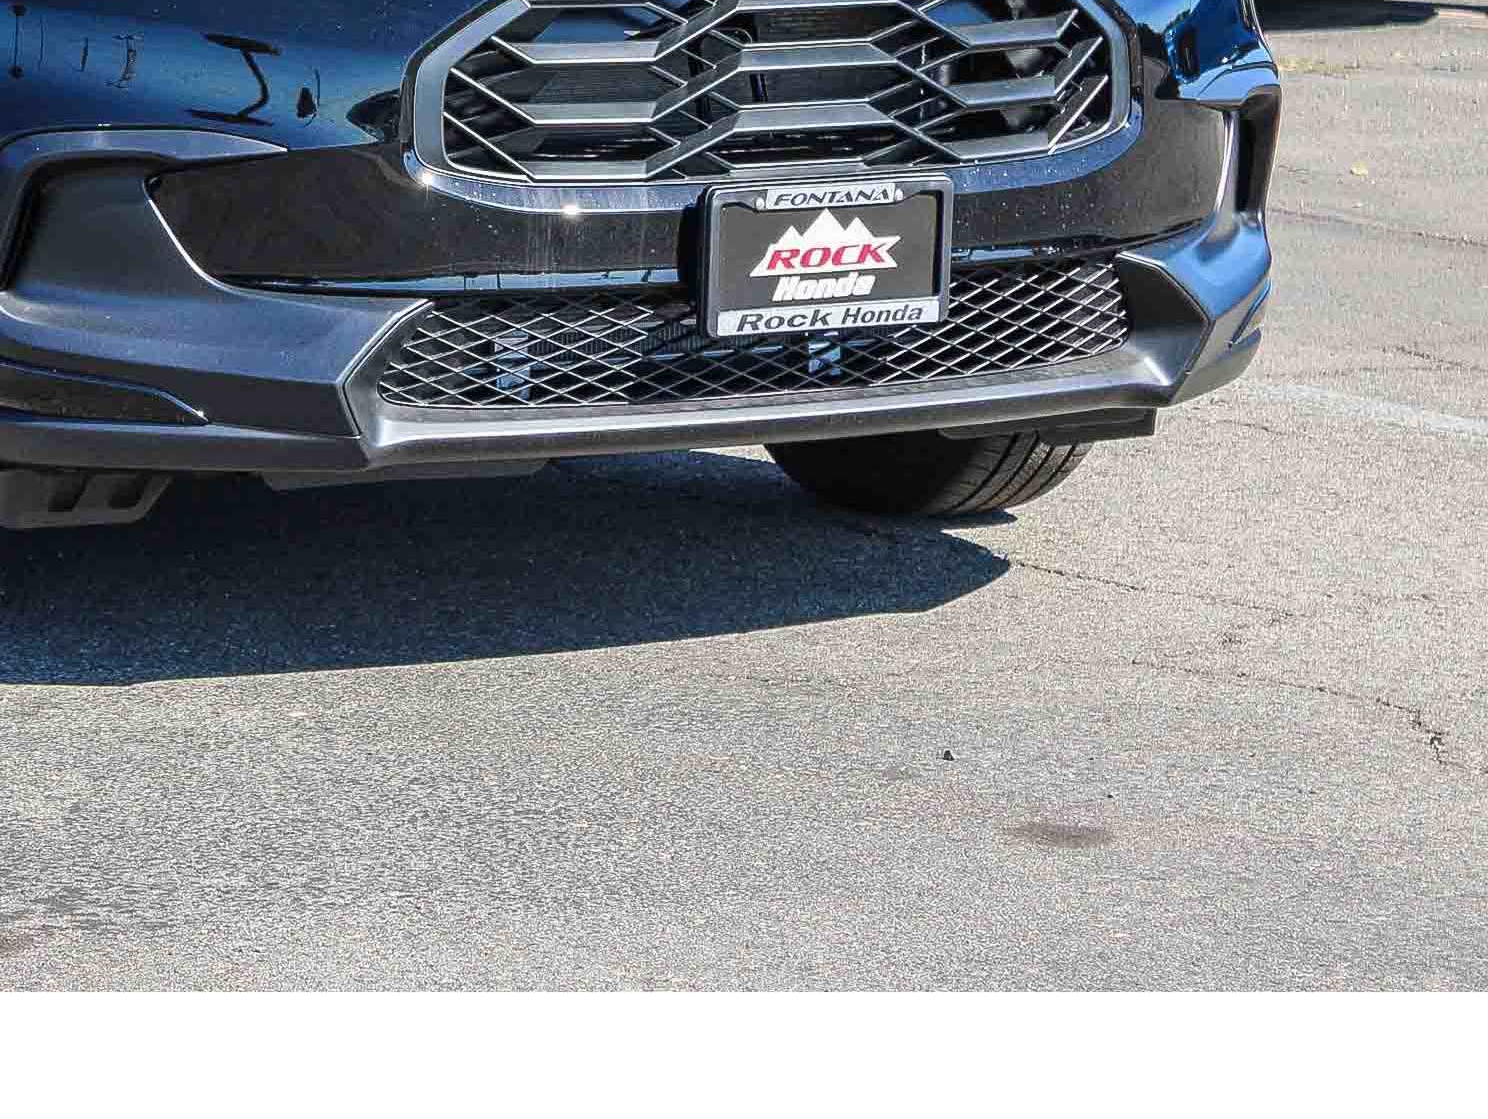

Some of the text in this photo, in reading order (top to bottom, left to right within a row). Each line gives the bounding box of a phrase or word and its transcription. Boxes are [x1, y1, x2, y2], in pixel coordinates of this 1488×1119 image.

[774, 188, 890, 206] FONTANA
[767, 243, 885, 270] ROCK
[772, 272, 875, 301] Honda
[736, 304, 923, 332] Rock Honda
